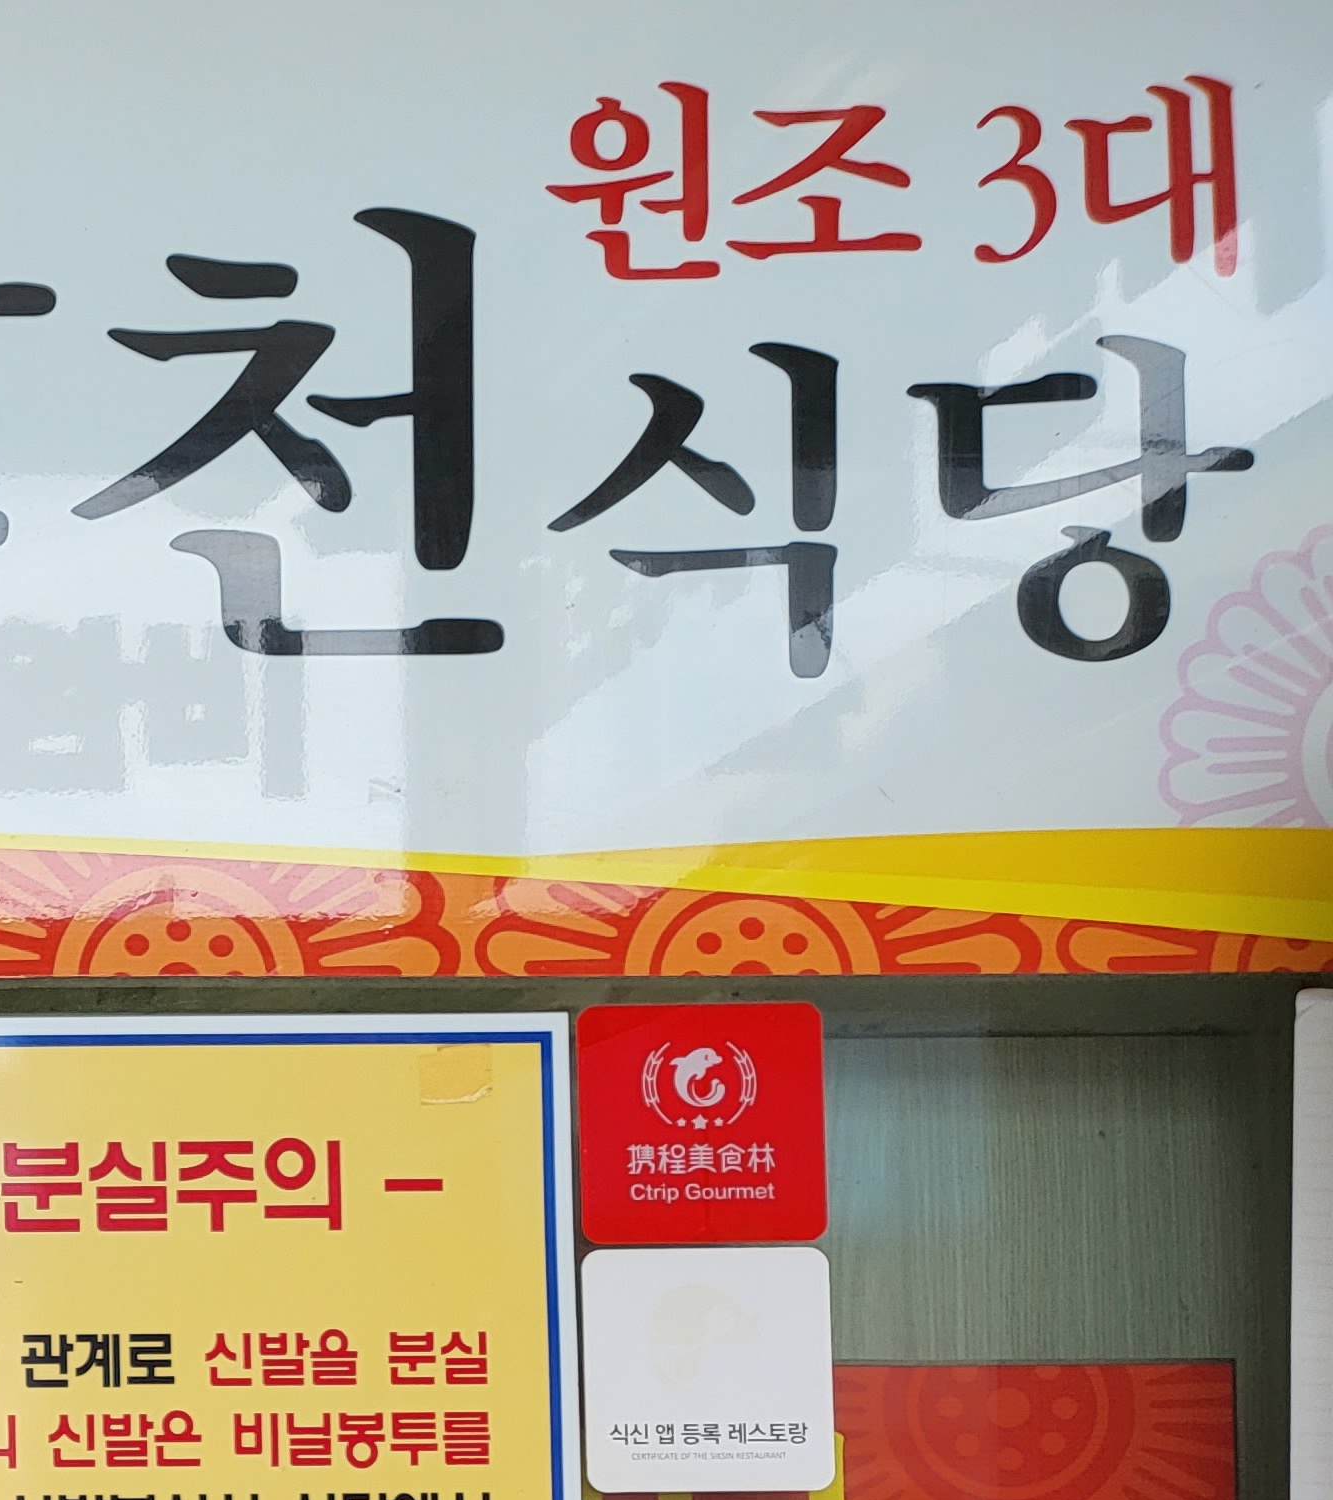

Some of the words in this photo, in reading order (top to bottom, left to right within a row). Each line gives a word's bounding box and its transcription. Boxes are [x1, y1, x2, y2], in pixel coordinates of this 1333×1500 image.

[548, 80, 923, 281] 원조
[974, 74, 1239, 274] 3대
[626, 1142, 776, 1174] 携程美食林
[1, 1137, 344, 1233] 분실주의
[630, 1183, 680, 1204] Ctrip
[684, 1182, 775, 1200] Gourmet
[20, 1332, 174, 1390] 관계로
[204, 1329, 359, 1388] 신발을
[387, 1331, 490, 1386] 분실
[47, 1413, 203, 1469] 신발은
[235, 1410, 492, 1469] 비닐봉투를
[609, 1423, 649, 1446] 식신
[655, 1423, 675, 1445] 앱
[680, 1423, 722, 1445] 등록
[728, 1422, 809, 1445] 레스토랑
[631, 1452, 679, 1461] CERTIFICATE
[693, 1452, 708, 1461] THE
[735, 1452, 787, 1460] RESTAURANT
